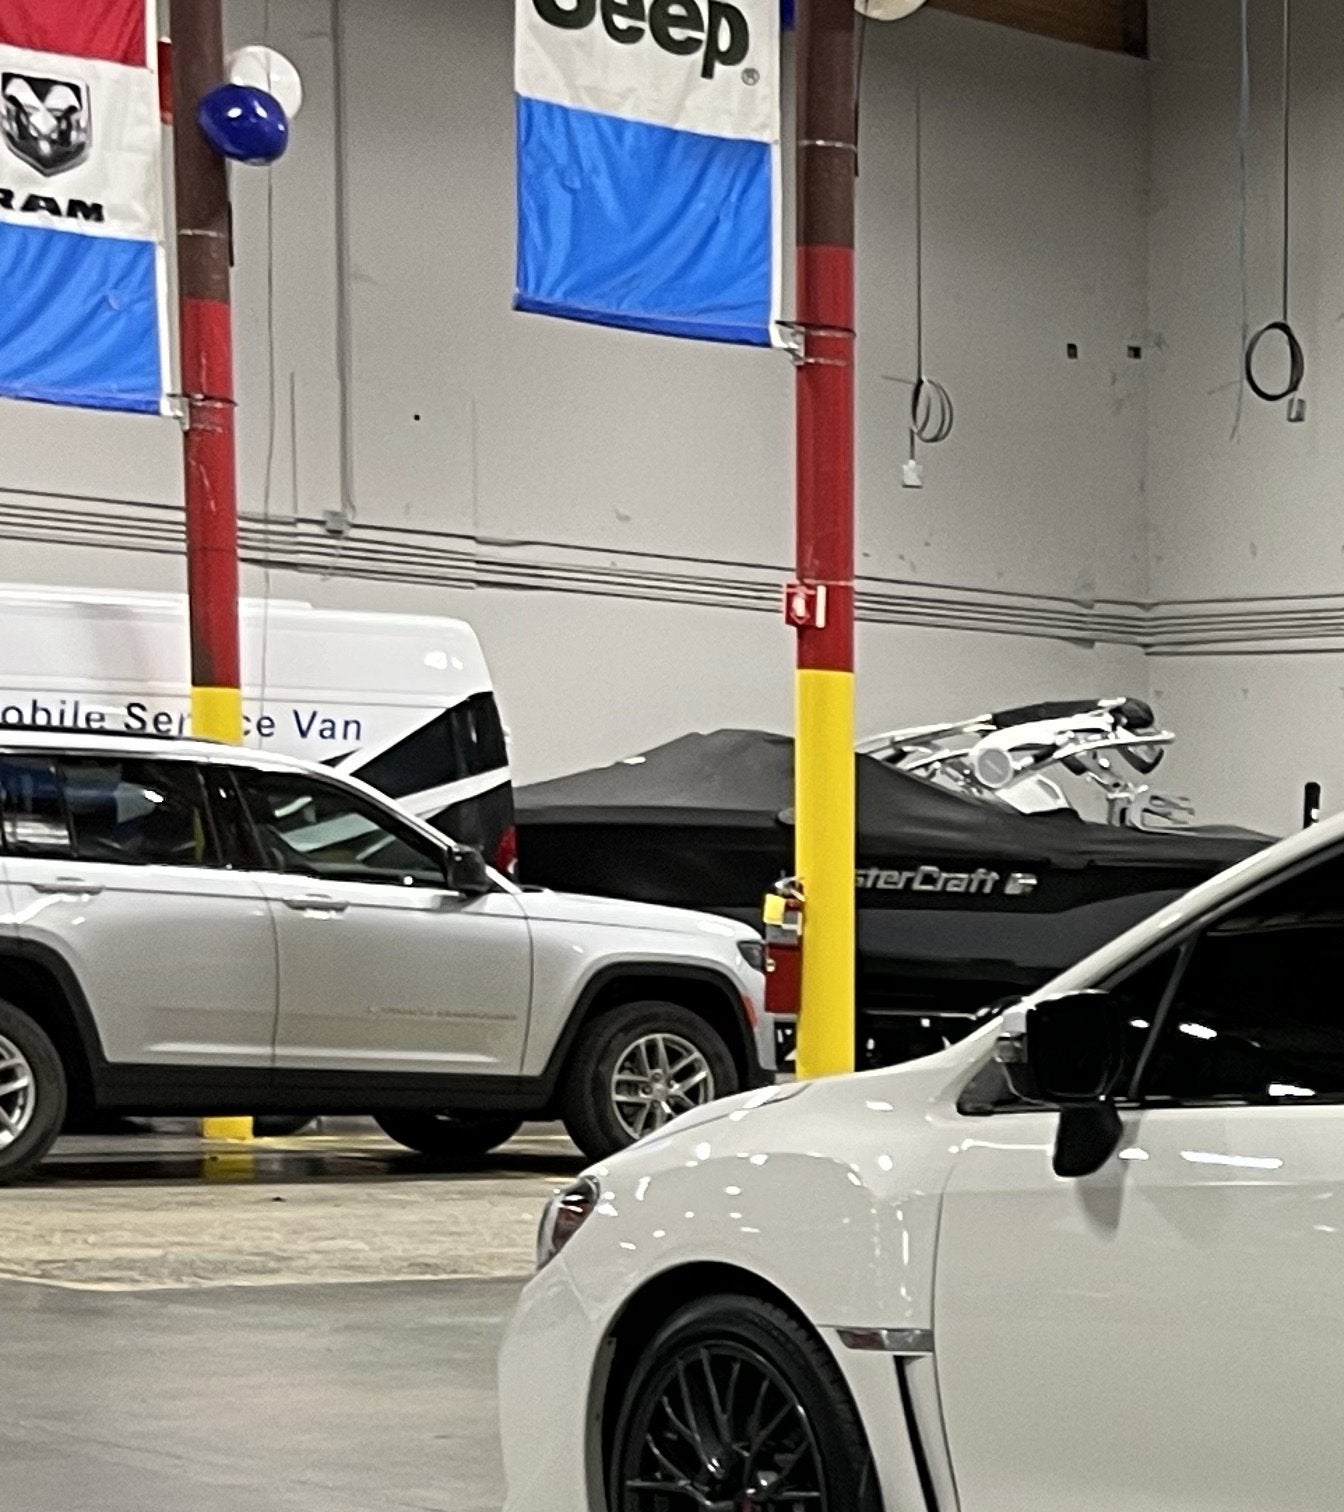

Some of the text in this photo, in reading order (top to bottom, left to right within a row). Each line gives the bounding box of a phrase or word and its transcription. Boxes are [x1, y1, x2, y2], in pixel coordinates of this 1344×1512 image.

[0, 187, 105, 223] RAM
[0, 699, 362, 740] obile Serce Van
